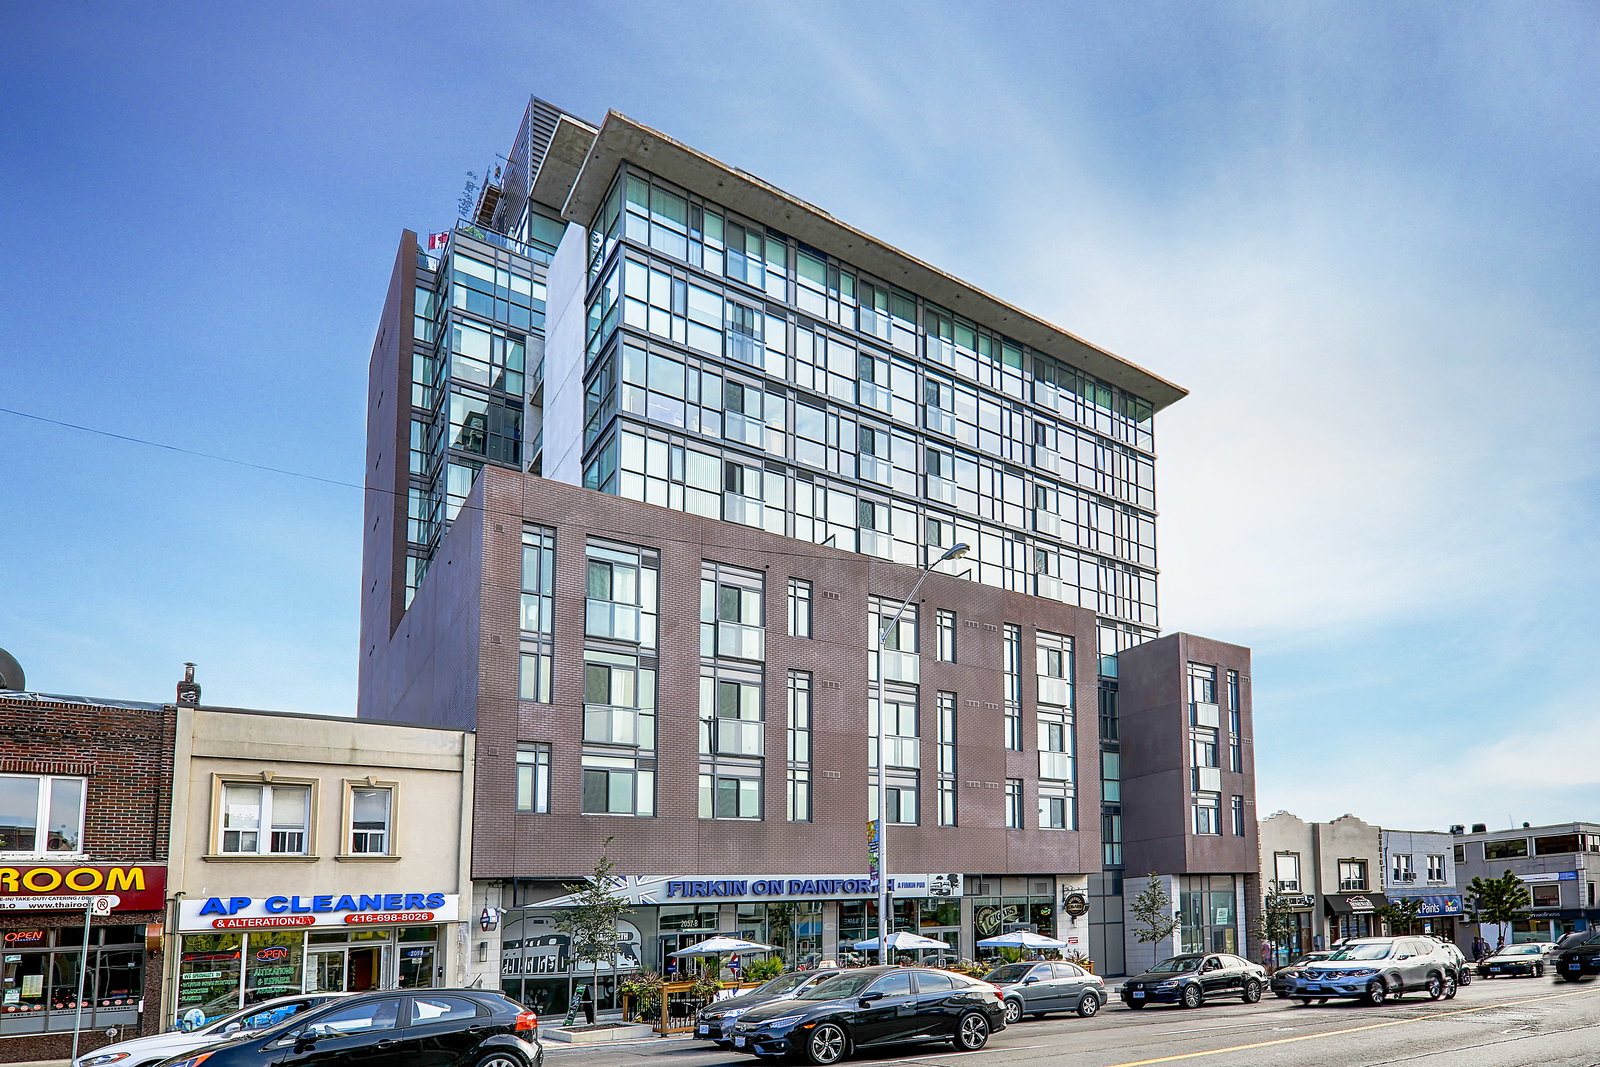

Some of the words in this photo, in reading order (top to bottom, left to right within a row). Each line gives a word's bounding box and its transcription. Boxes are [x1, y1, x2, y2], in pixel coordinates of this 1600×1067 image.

[0, 867, 146, 892] ROOM
[667, 880, 748, 897] FIRKIN
[752, 880, 785, 895] ON
[789, 879, 896, 894] DANFORH
[28, 901, 94, 909] www.thairoo
[199, 897, 252, 915] AP
[265, 893, 446, 913] CLEANERS
[1421, 903, 1440, 913] Paints
[351, 913, 429, 922] 416-698-8026
[216, 919, 225, 927] &
[5, 931, 43, 942] OPEN
[256, 949, 288, 959] OPEN
